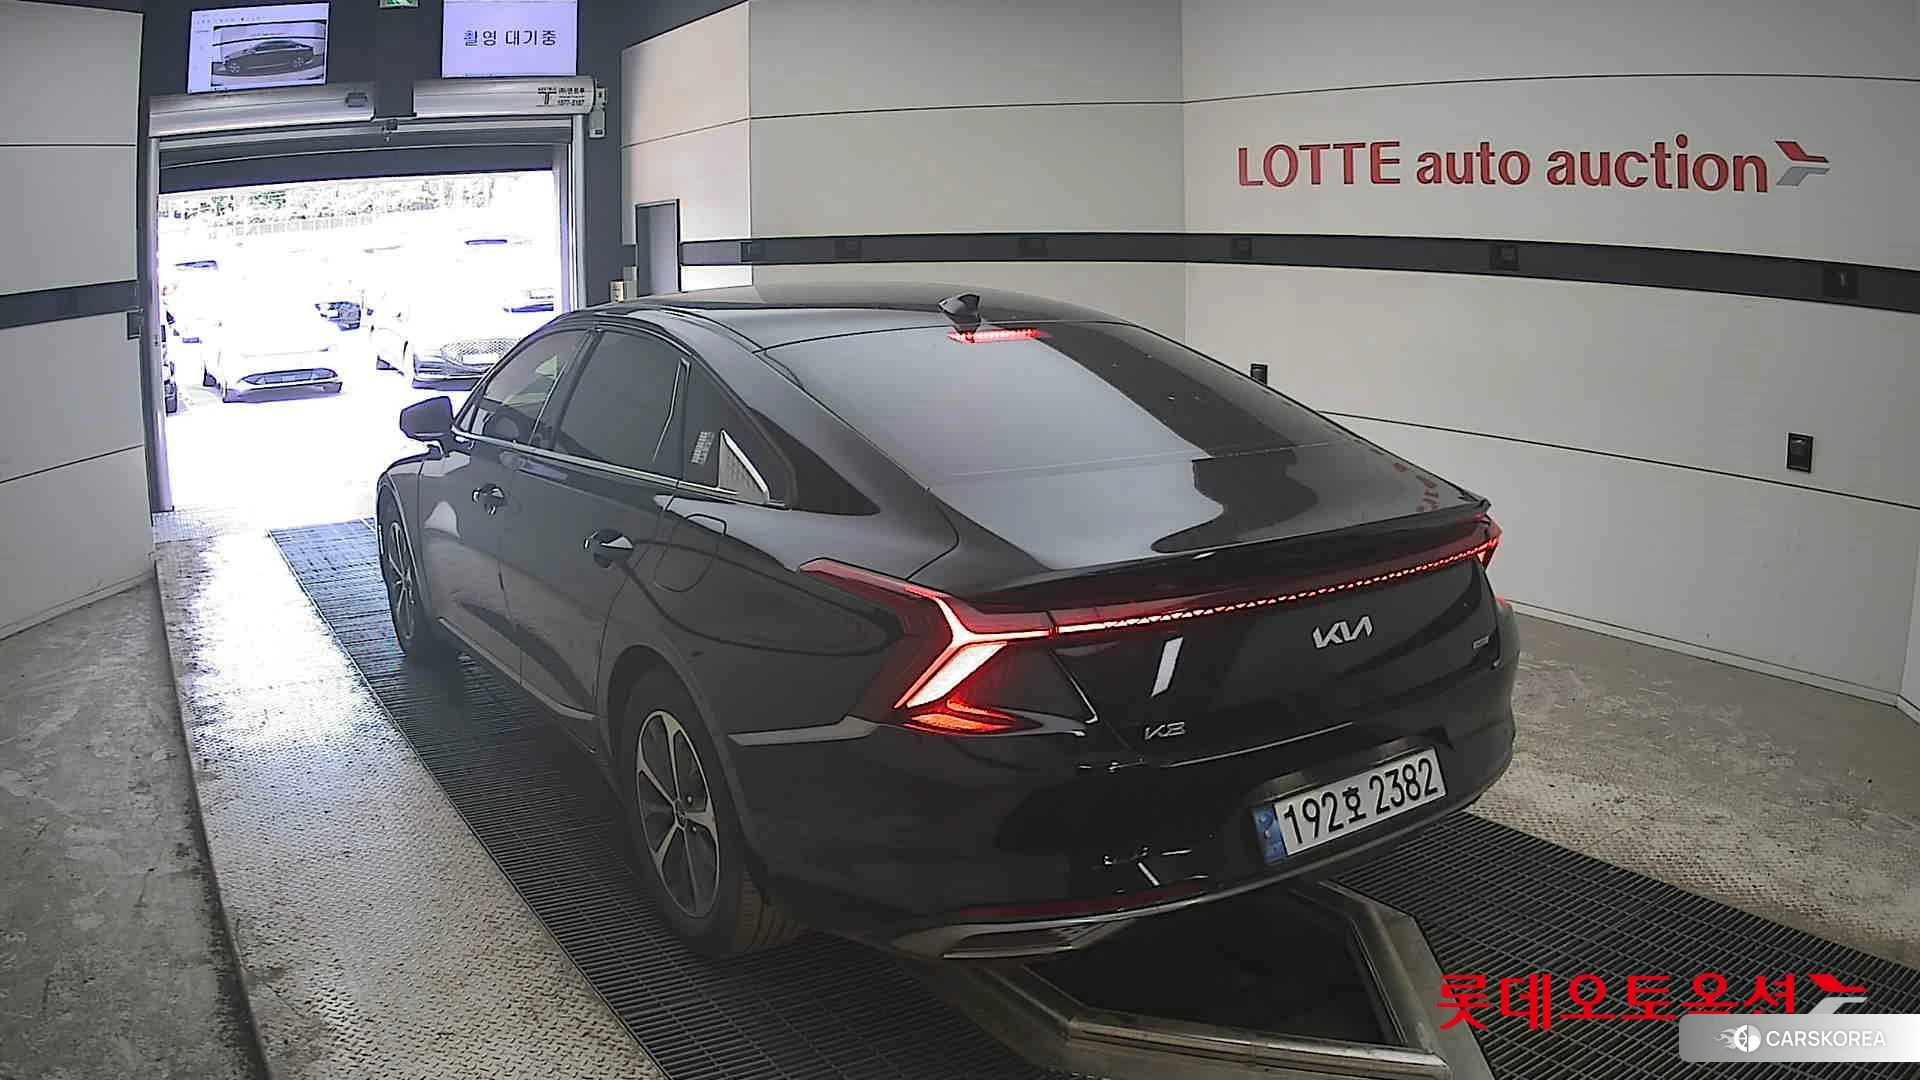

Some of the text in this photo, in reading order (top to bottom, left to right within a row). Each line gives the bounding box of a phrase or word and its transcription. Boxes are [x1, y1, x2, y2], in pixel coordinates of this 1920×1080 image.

[505, 30, 556, 46] 대기중
[1238, 134, 1768, 193] LOTTE auto auction
[1312, 615, 1373, 649] KIA
[1144, 721, 1186, 740] K8
[1284, 758, 1438, 844] 192호 2382
